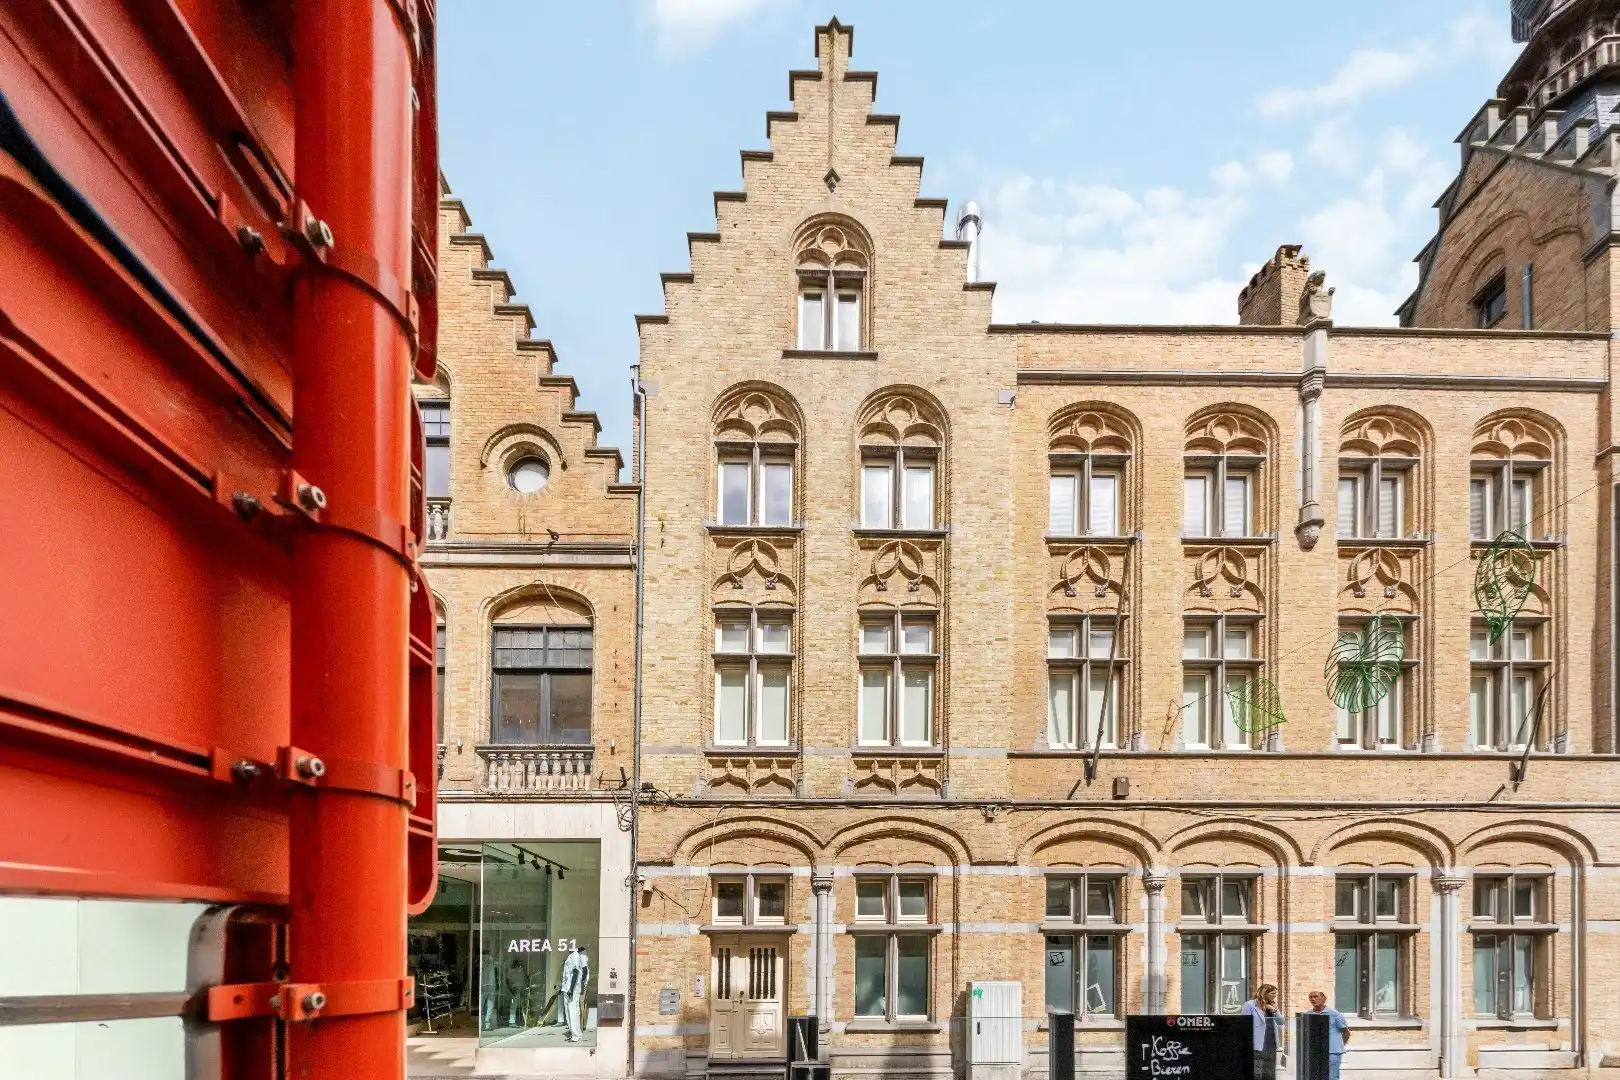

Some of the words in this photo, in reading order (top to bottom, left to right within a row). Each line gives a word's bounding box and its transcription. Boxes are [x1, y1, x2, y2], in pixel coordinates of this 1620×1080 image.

[507, 938, 552, 953] AREA
[557, 938, 579, 952] 51
[1176, 1016, 1215, 1027] OMER.
